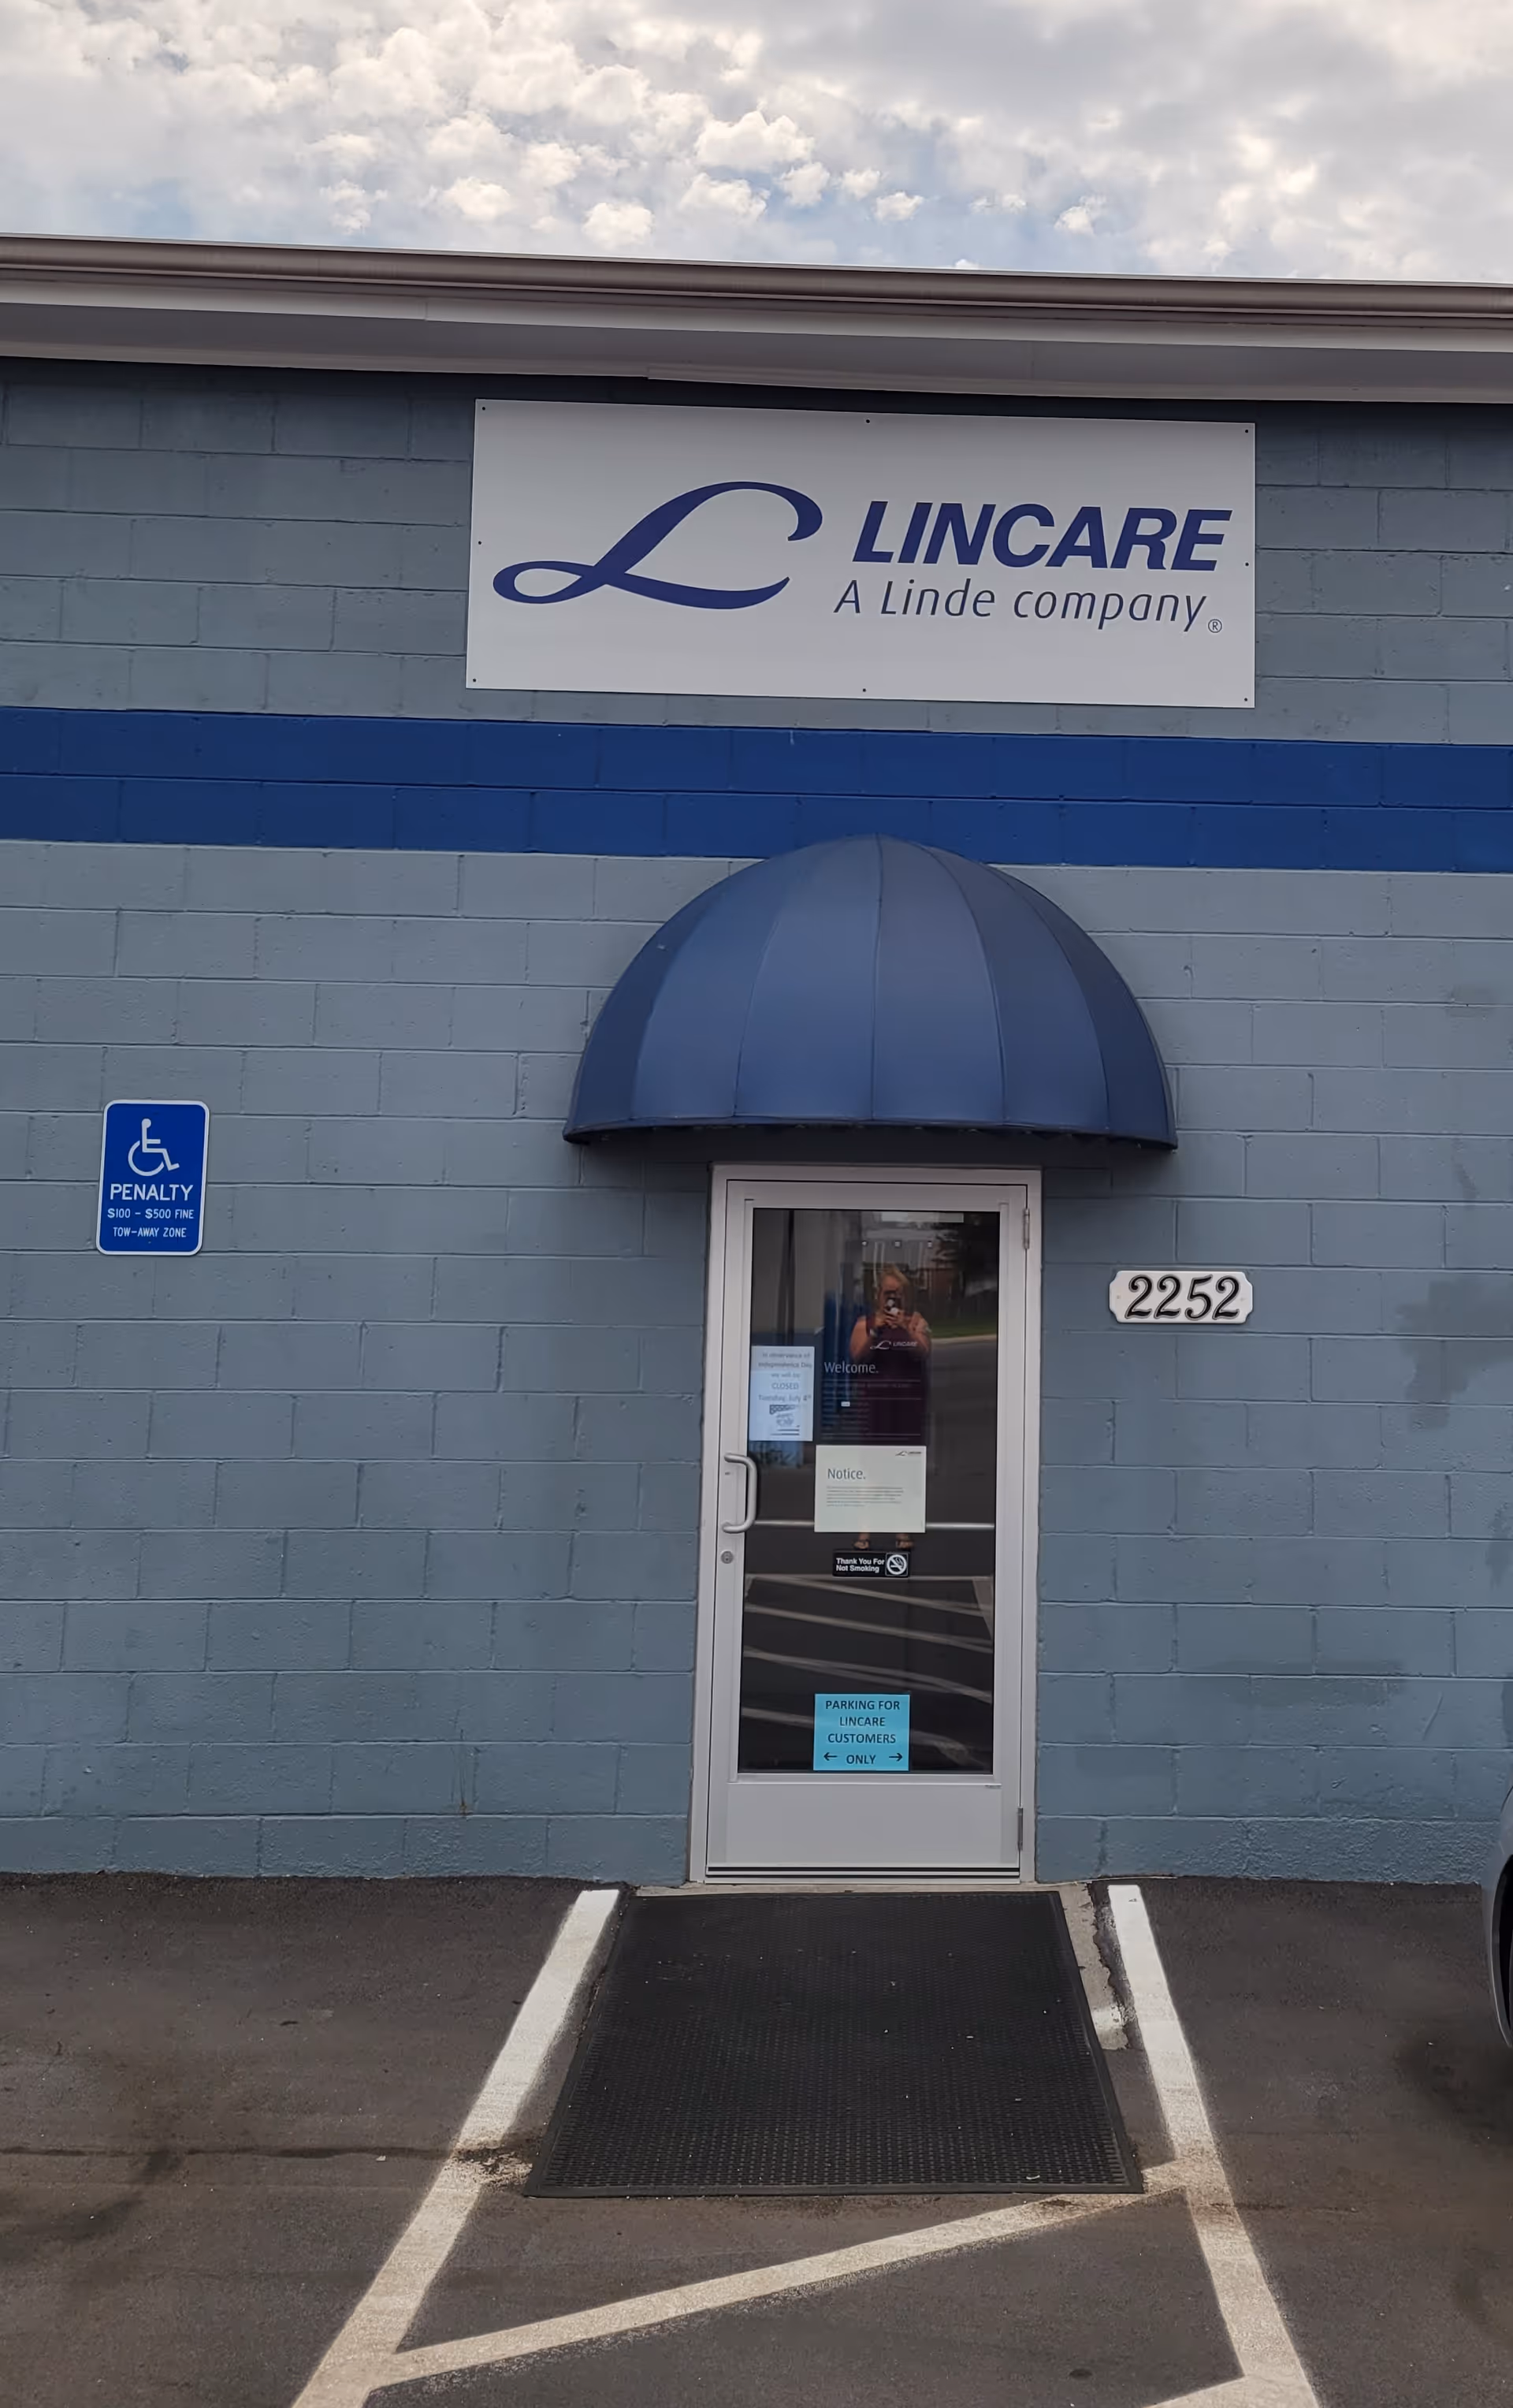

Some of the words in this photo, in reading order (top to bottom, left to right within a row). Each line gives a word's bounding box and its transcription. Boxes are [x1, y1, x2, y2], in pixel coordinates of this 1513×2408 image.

[852, 500, 1233, 571] LINCARE
[833, 580, 862, 615] A
[881, 578, 995, 620] Linde
[110, 1183, 194, 1201] PENALTY
[107, 1208, 131, 1219] $100
[145, 1208, 171, 1219] $500
[175, 1209, 195, 1220] FINE
[113, 1226, 160, 1237] TOW-AWAY
[162, 1227, 187, 1238] ZONE
[1125, 1274, 1240, 1321] 2252
[823, 1360, 879, 1374] Welcome.
[789, 1394, 801, 1403] July
[827, 1468, 866, 1480] Notice.
[849, 1565, 879, 1573] Smoking
[825, 1700, 875, 1710] PARKING
[879, 1700, 900, 1710] FOR
[839, 1717, 887, 1727] LINCARE
[827, 1733, 896, 1744] CUSTOMERS
[846, 1755, 876, 1765] ONLY
